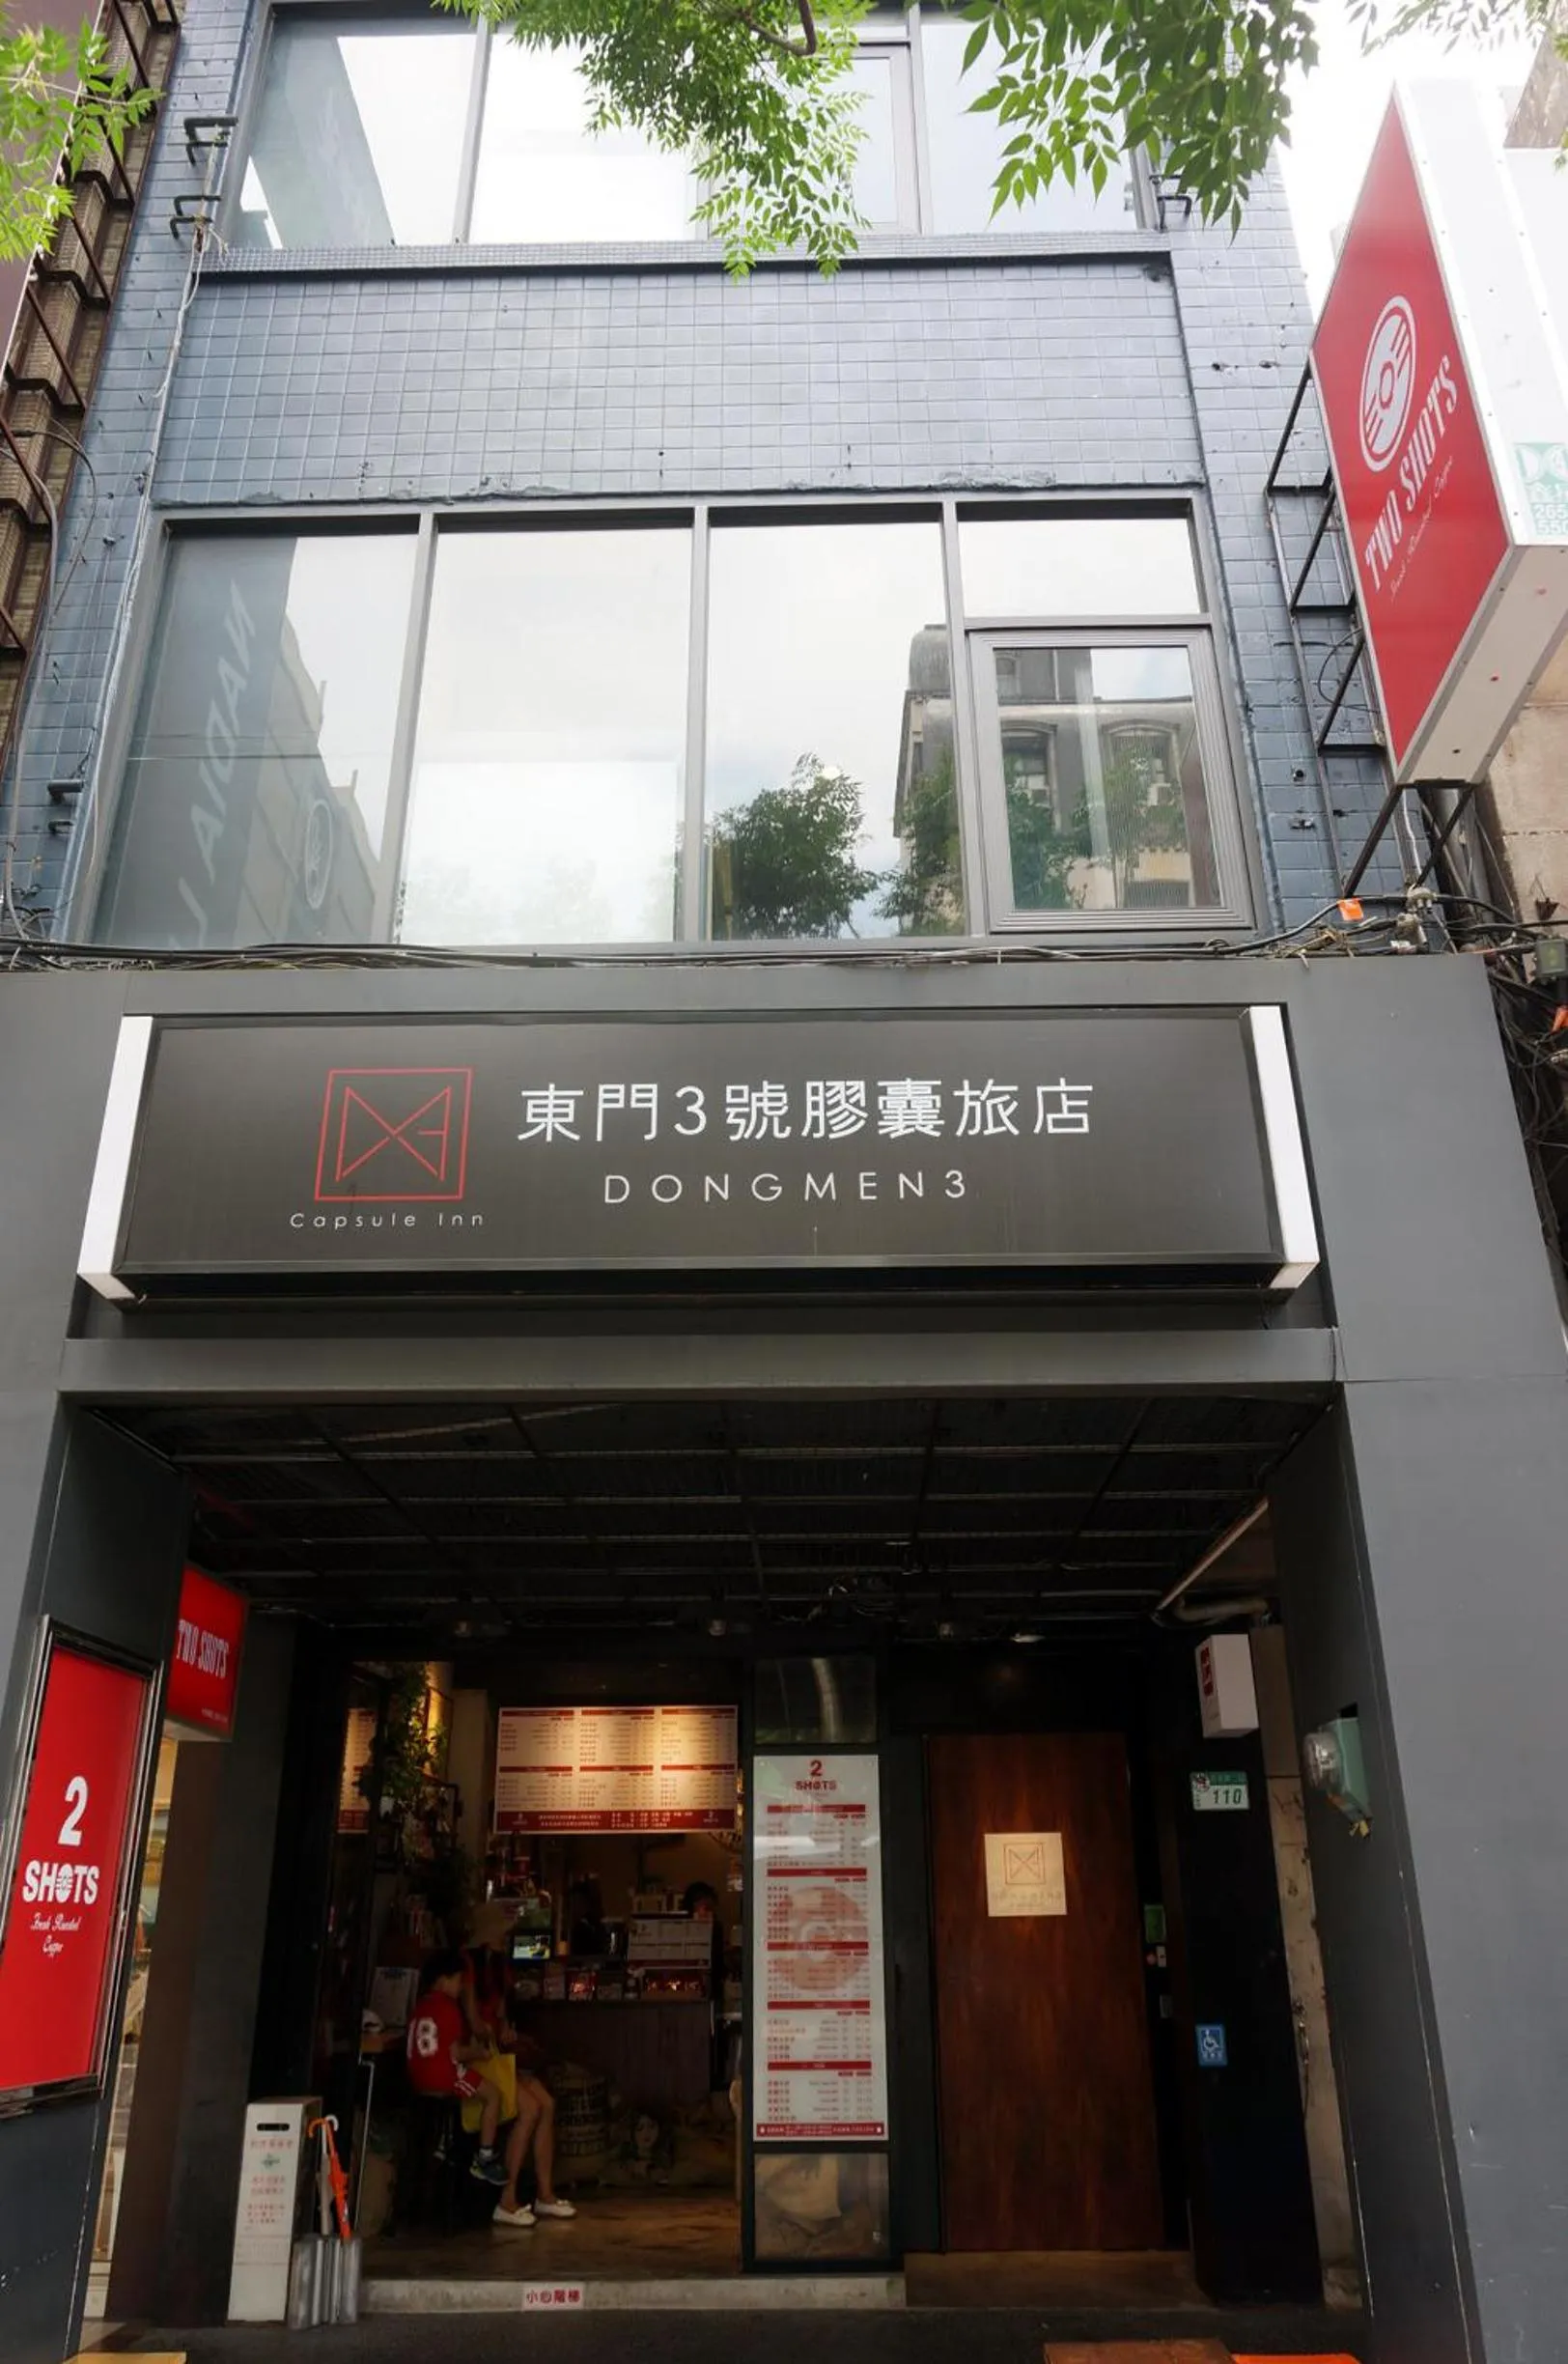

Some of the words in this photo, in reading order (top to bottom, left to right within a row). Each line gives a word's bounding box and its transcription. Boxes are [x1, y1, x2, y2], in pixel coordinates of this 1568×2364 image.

[1364, 490, 1402, 593] TWO
[1398, 354, 1458, 513] SHOTS
[518, 1078, 1094, 1142] 東門3號膠囊旅店
[604, 1169, 966, 1203] DONGMEN3
[290, 1212, 417, 1230] Capsule
[438, 1211, 484, 1228] Inn
[809, 1759, 824, 1777] 2
[57, 1775, 89, 1846] 2
[1213, 1788, 1242, 1805] 110
[21, 1859, 100, 1905] SHOTS
